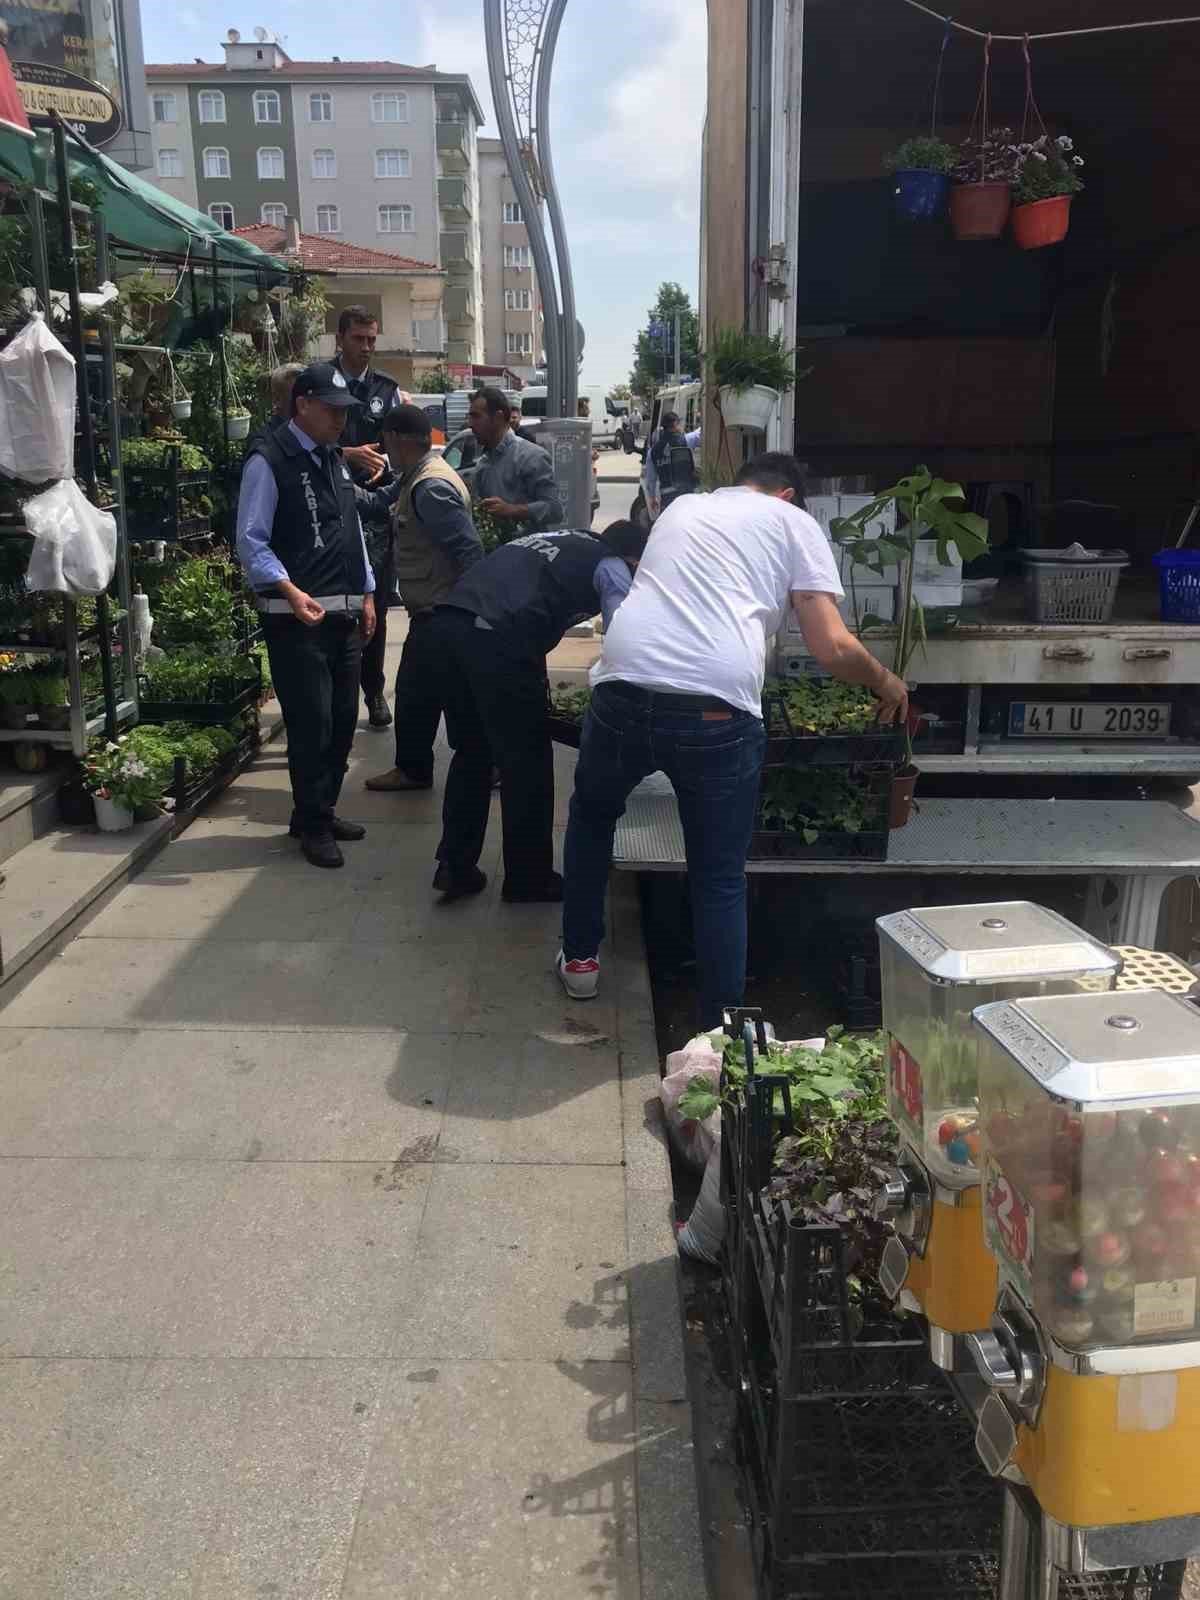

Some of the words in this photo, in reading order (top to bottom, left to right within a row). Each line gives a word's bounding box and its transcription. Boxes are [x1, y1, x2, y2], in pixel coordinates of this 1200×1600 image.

[300, 471, 325, 548] ZABITA
[1029, 707, 1054, 731] 41
[1070, 707, 1083, 731] U
[1104, 707, 1161, 732] 2039
